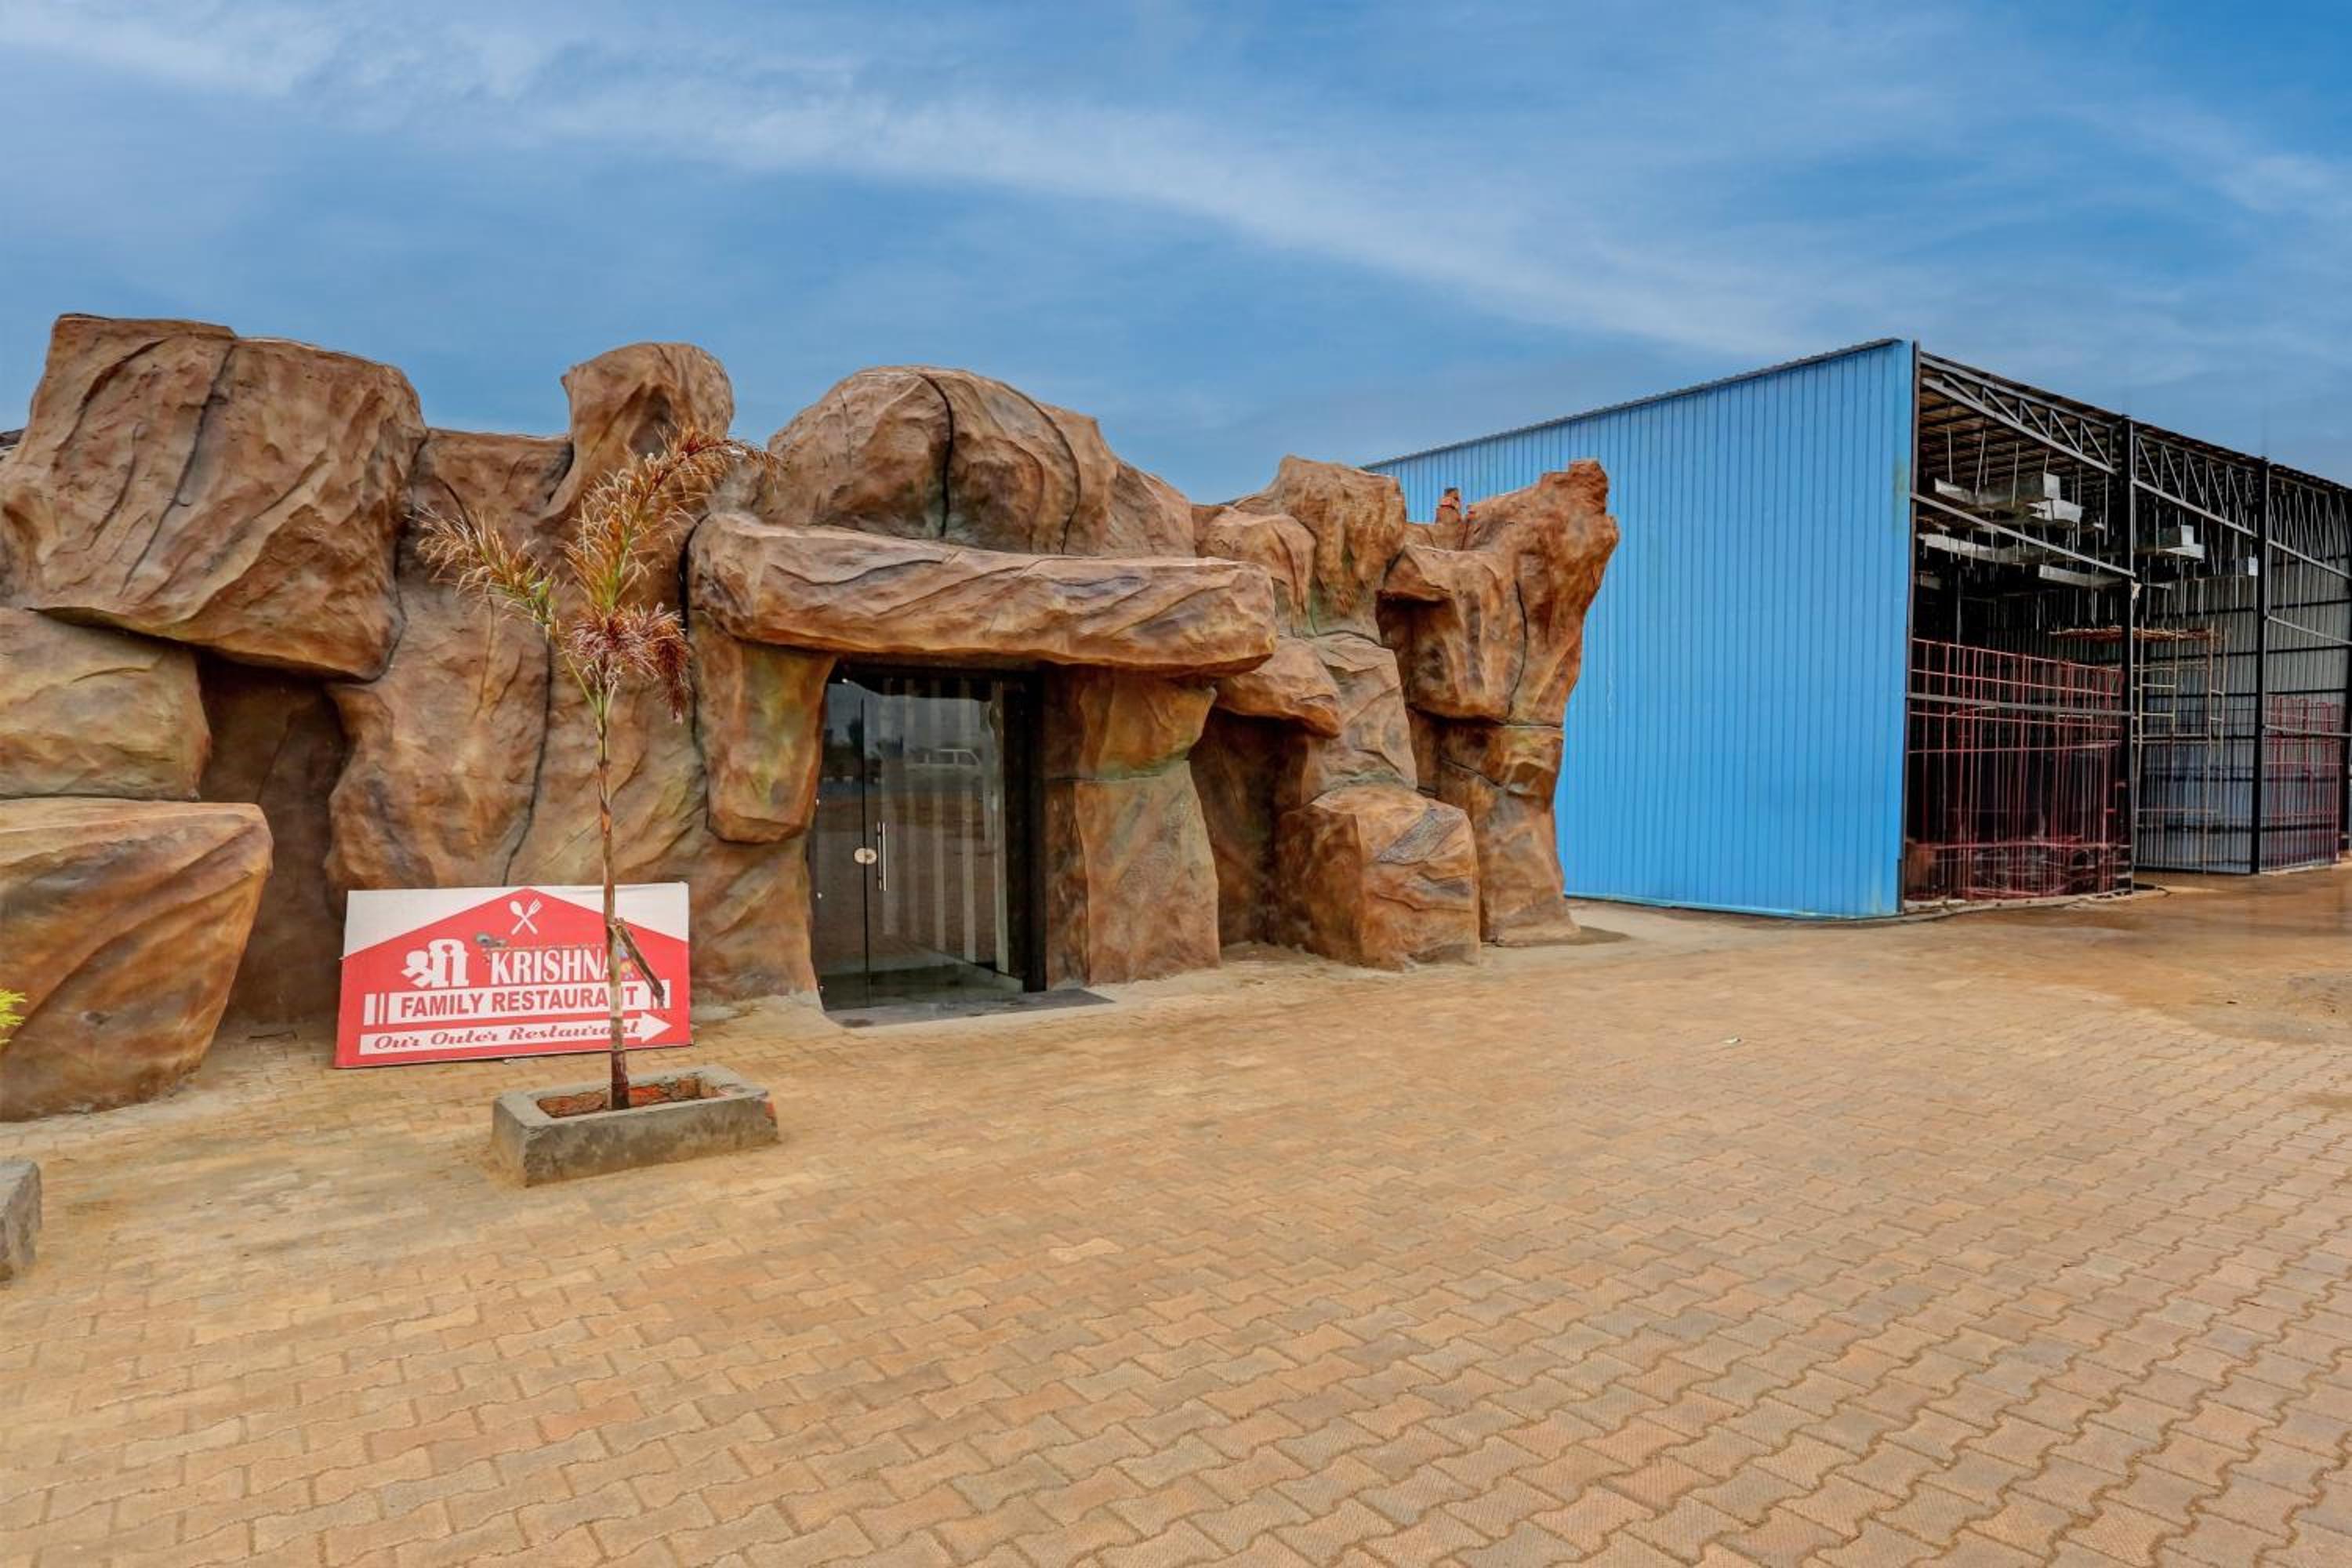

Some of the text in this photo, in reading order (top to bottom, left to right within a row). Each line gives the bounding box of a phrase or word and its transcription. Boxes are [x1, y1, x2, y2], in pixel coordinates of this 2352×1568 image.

[401, 938, 470, 989] श्री
[401, 985, 639, 1018] FAMILY RESTAURAT
[374, 1035, 420, 1050] Our
[508, 1021, 639, 1040] Restaurat
